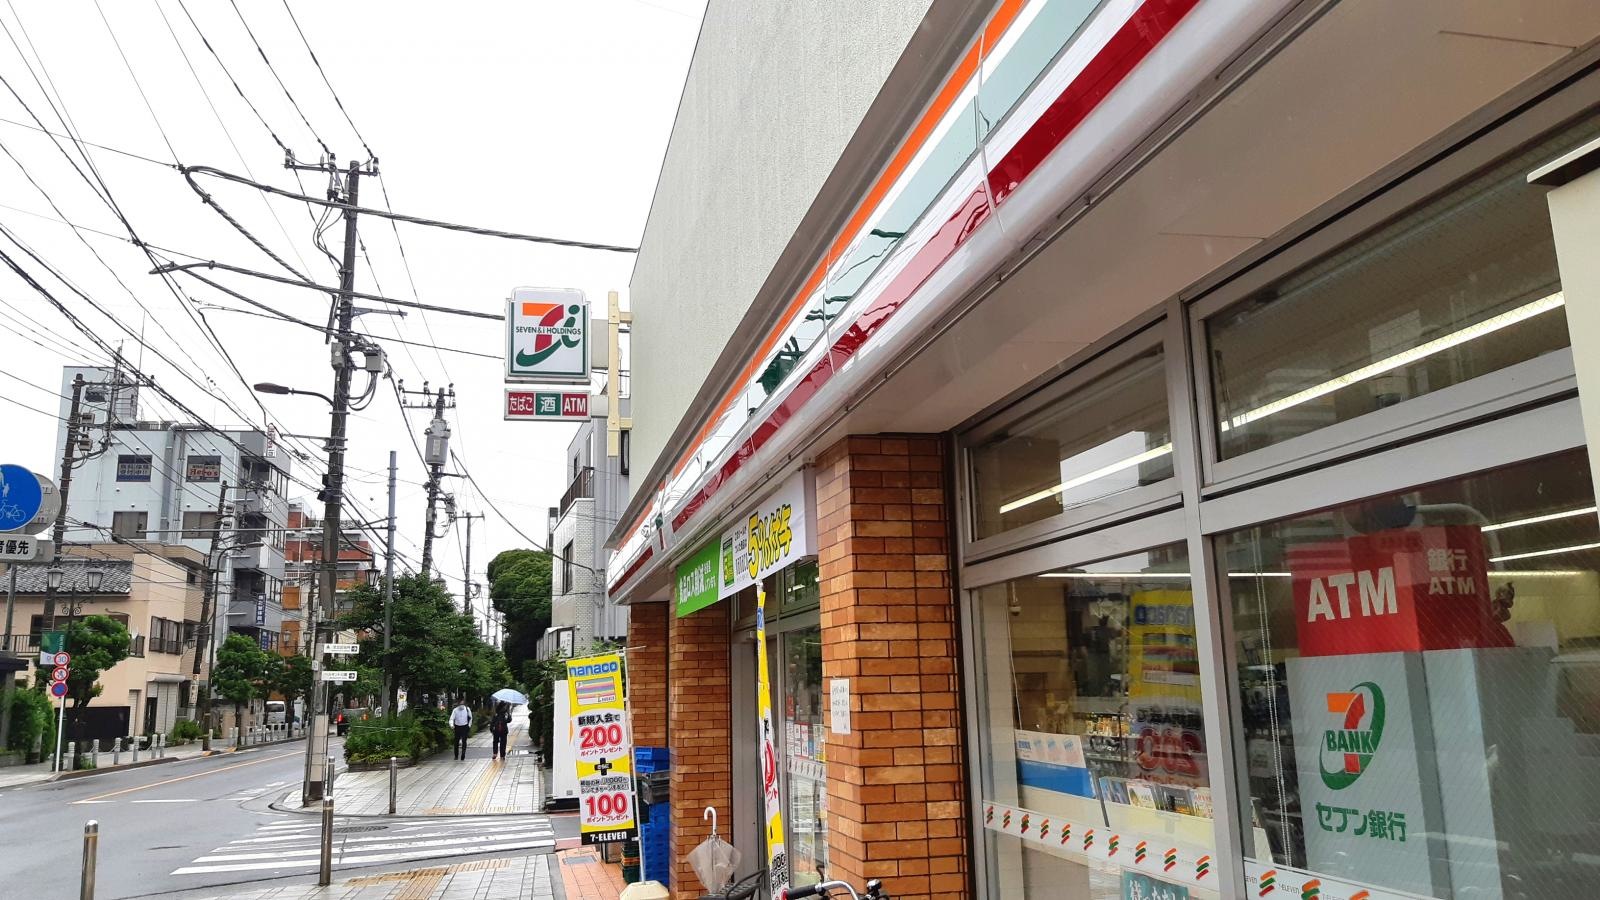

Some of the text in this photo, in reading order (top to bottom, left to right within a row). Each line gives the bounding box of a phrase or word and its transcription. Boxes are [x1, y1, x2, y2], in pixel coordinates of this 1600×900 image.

[546, 327, 582, 335] HOLDINGS
[509, 395, 586, 413] たばこ 酒 ATM
[748, 504, 792, 580] 5%付与
[1427, 548, 1467, 571] 銀行
[1307, 566, 1398, 623] ATM
[1428, 576, 1476, 595] ATM
[57, 655, 67, 663] 30
[569, 661, 618, 677] nanaco
[578, 712, 620, 726] 新規入会で
[580, 723, 623, 749] 200
[1325, 729, 1374, 753] BANK
[580, 747, 623, 757] ポイントプレゼント
[586, 792, 627, 817] 100
[586, 814, 629, 823] ポイントプレゼント
[1315, 802, 1406, 842] セブン銀行
